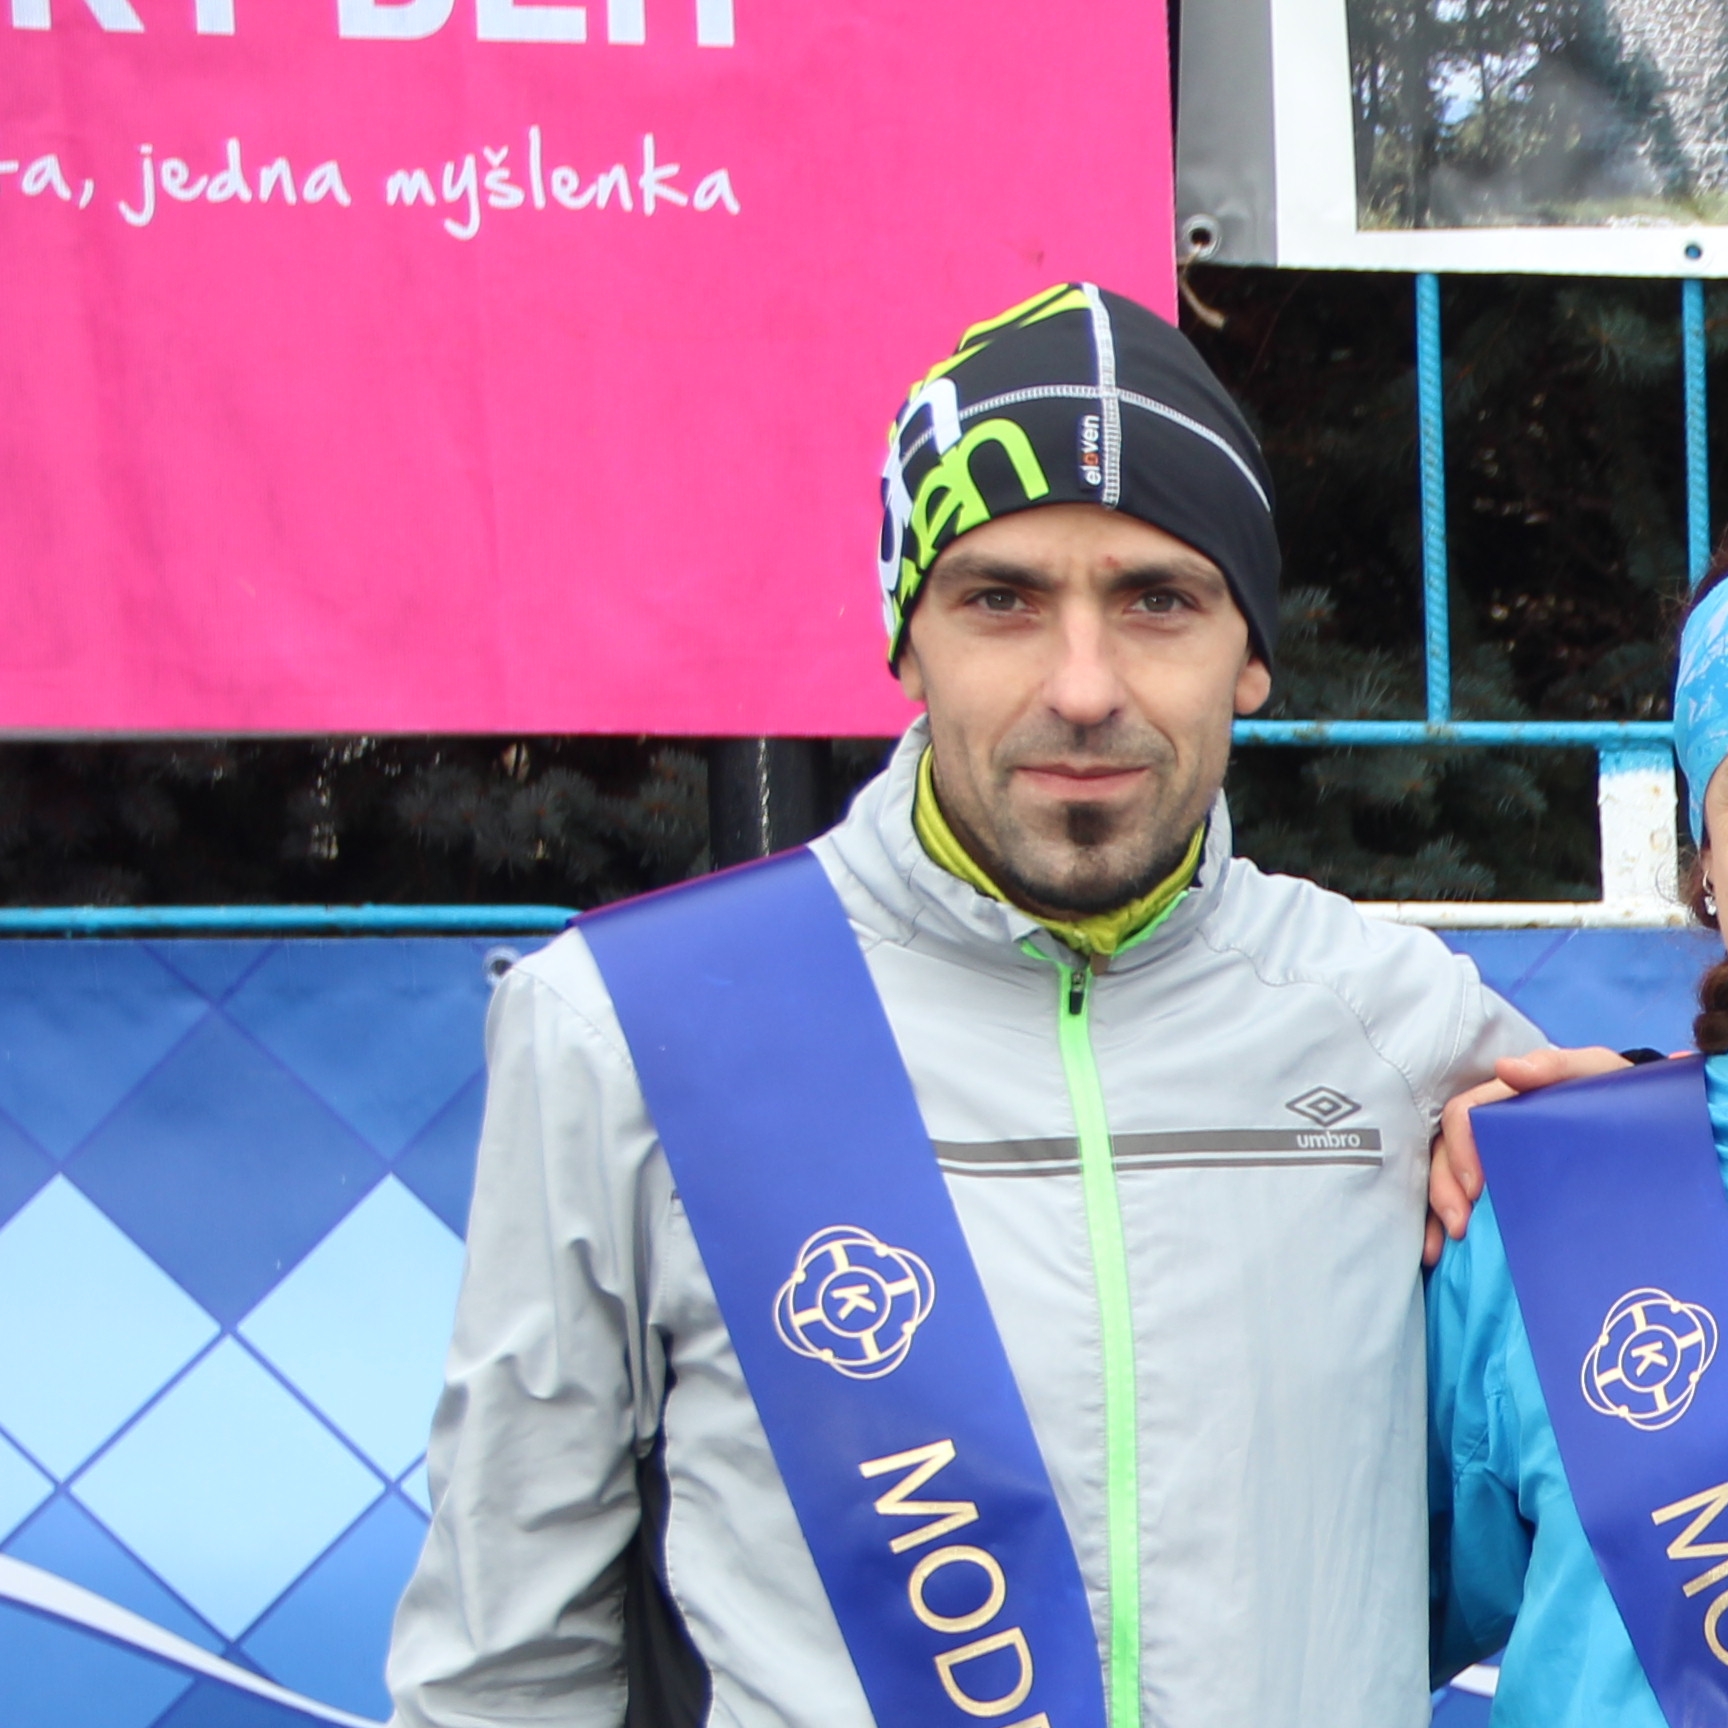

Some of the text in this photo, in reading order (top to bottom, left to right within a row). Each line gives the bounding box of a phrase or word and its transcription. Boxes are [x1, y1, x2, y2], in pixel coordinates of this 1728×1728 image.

[118, 137, 351, 226] jedna
[385, 125, 741, 240] myšlenka
[1296, 1130, 1361, 1149] umbro
